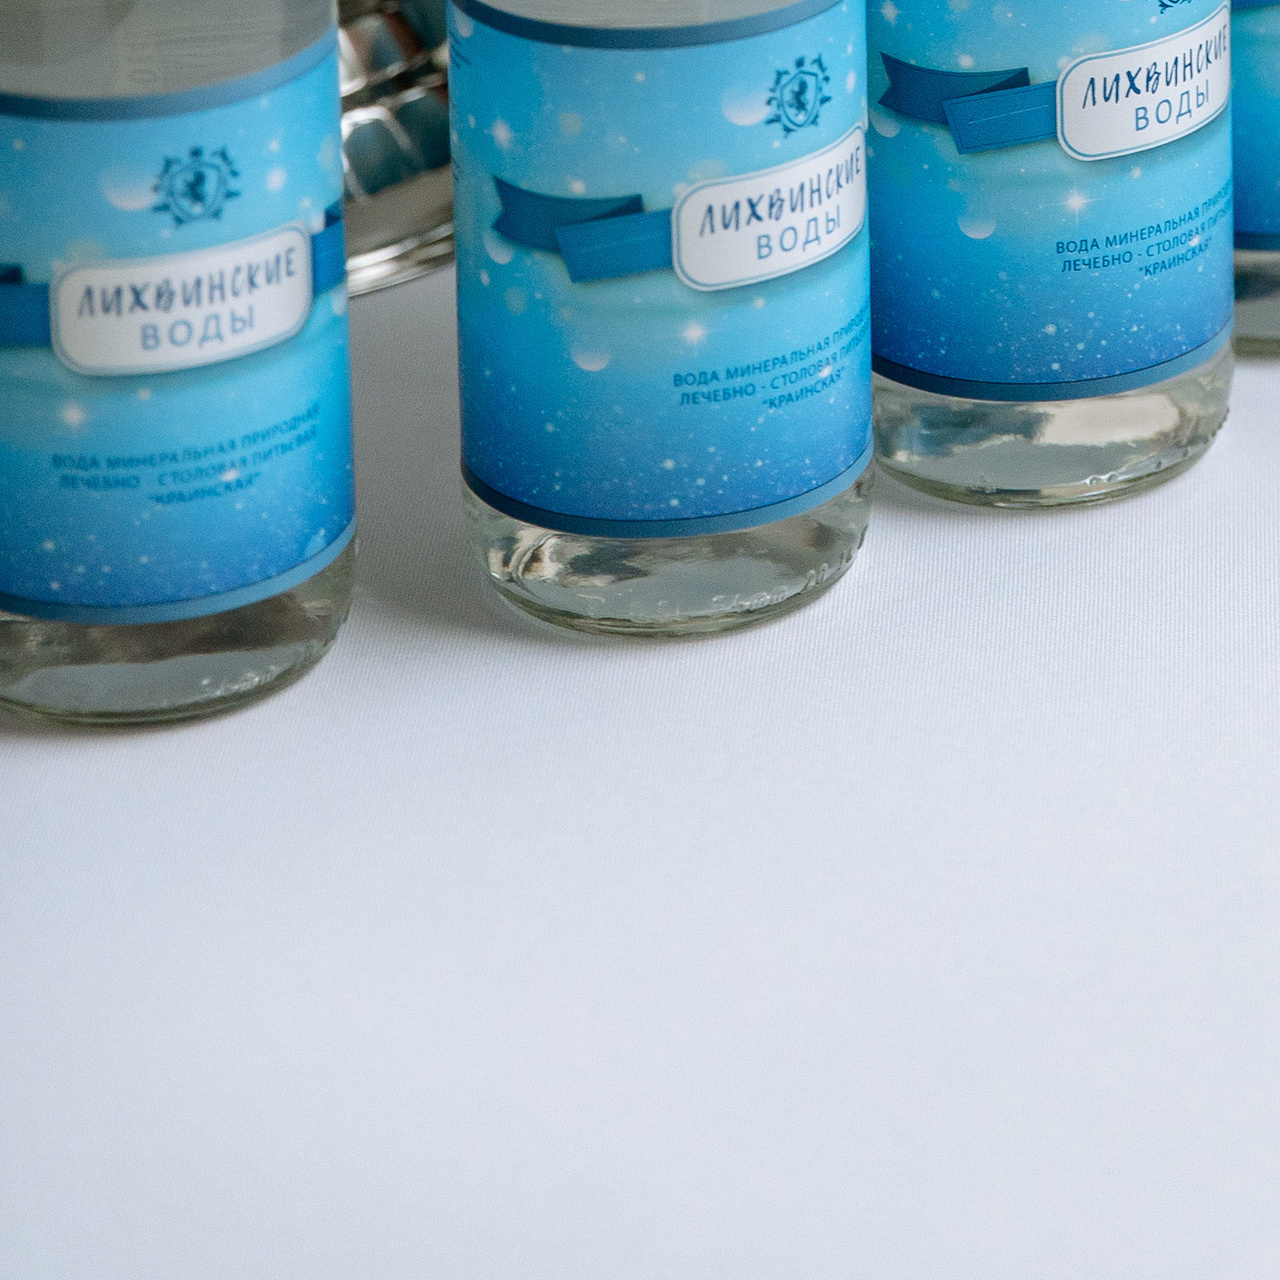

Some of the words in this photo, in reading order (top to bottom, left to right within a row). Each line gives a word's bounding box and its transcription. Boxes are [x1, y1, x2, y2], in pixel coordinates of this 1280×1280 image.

[1081, 23, 1228, 110] ЛИХВИНСКИЕ
[1134, 78, 1210, 132] ВОДЫ
[699, 145, 861, 237] ЛИХВИНСКИЕ
[755, 203, 841, 261] ВОДЫ
[1055, 238, 1100, 254] ВОДА
[1105, 206, 1200, 248] МИНЕРАЛЬНАЯ
[76, 245, 297, 320] ЛИХВИНСКИЕ
[1061, 250, 1133, 273] ЛЕЧЕБНО
[139, 305, 256, 352] ВОДЫ
[673, 369, 720, 388] ВОДА
[725, 336, 830, 381] МИНЕРАЛЬНАЯ
[679, 383, 757, 406] ЛЕЧЕБНО
